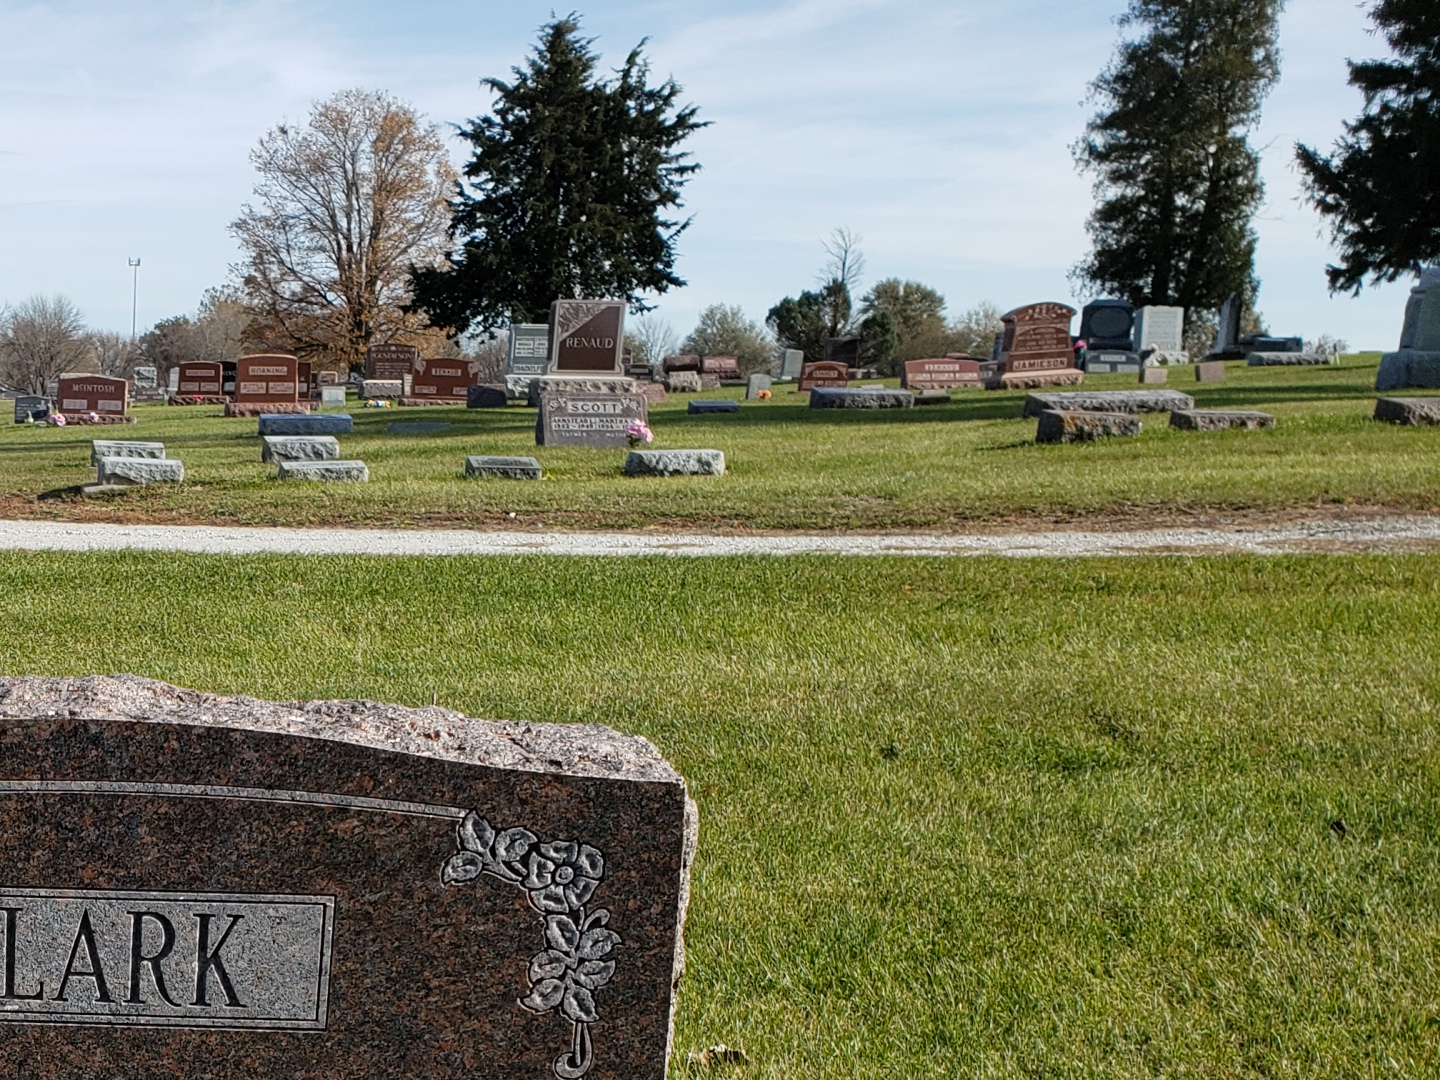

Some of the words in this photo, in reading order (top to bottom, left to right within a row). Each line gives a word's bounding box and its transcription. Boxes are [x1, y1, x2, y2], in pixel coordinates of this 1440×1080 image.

[565, 337, 614, 349] RENAUD
[1014, 359, 1065, 370] JAMIESON
[570, 403, 619, 413] SCOTT
